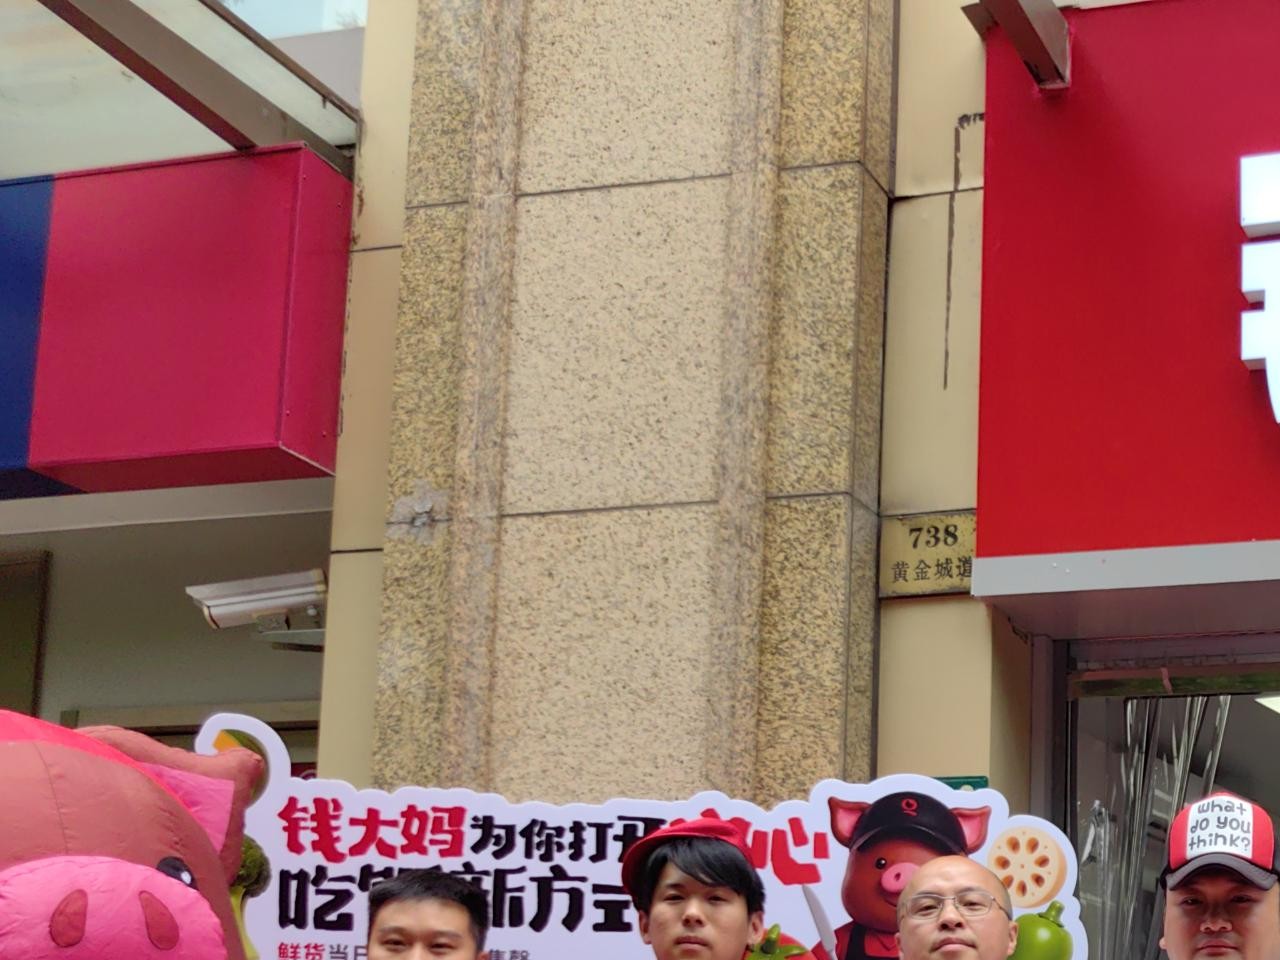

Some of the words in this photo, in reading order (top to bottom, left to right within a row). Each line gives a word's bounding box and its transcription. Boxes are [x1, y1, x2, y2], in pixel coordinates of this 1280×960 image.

[908, 524, 959, 549] 738
[890, 555, 973, 583] 黄金城道
[1190, 817, 1210, 834] do
[1216, 816, 1251, 834] you
[1188, 832, 1251, 852] think?
